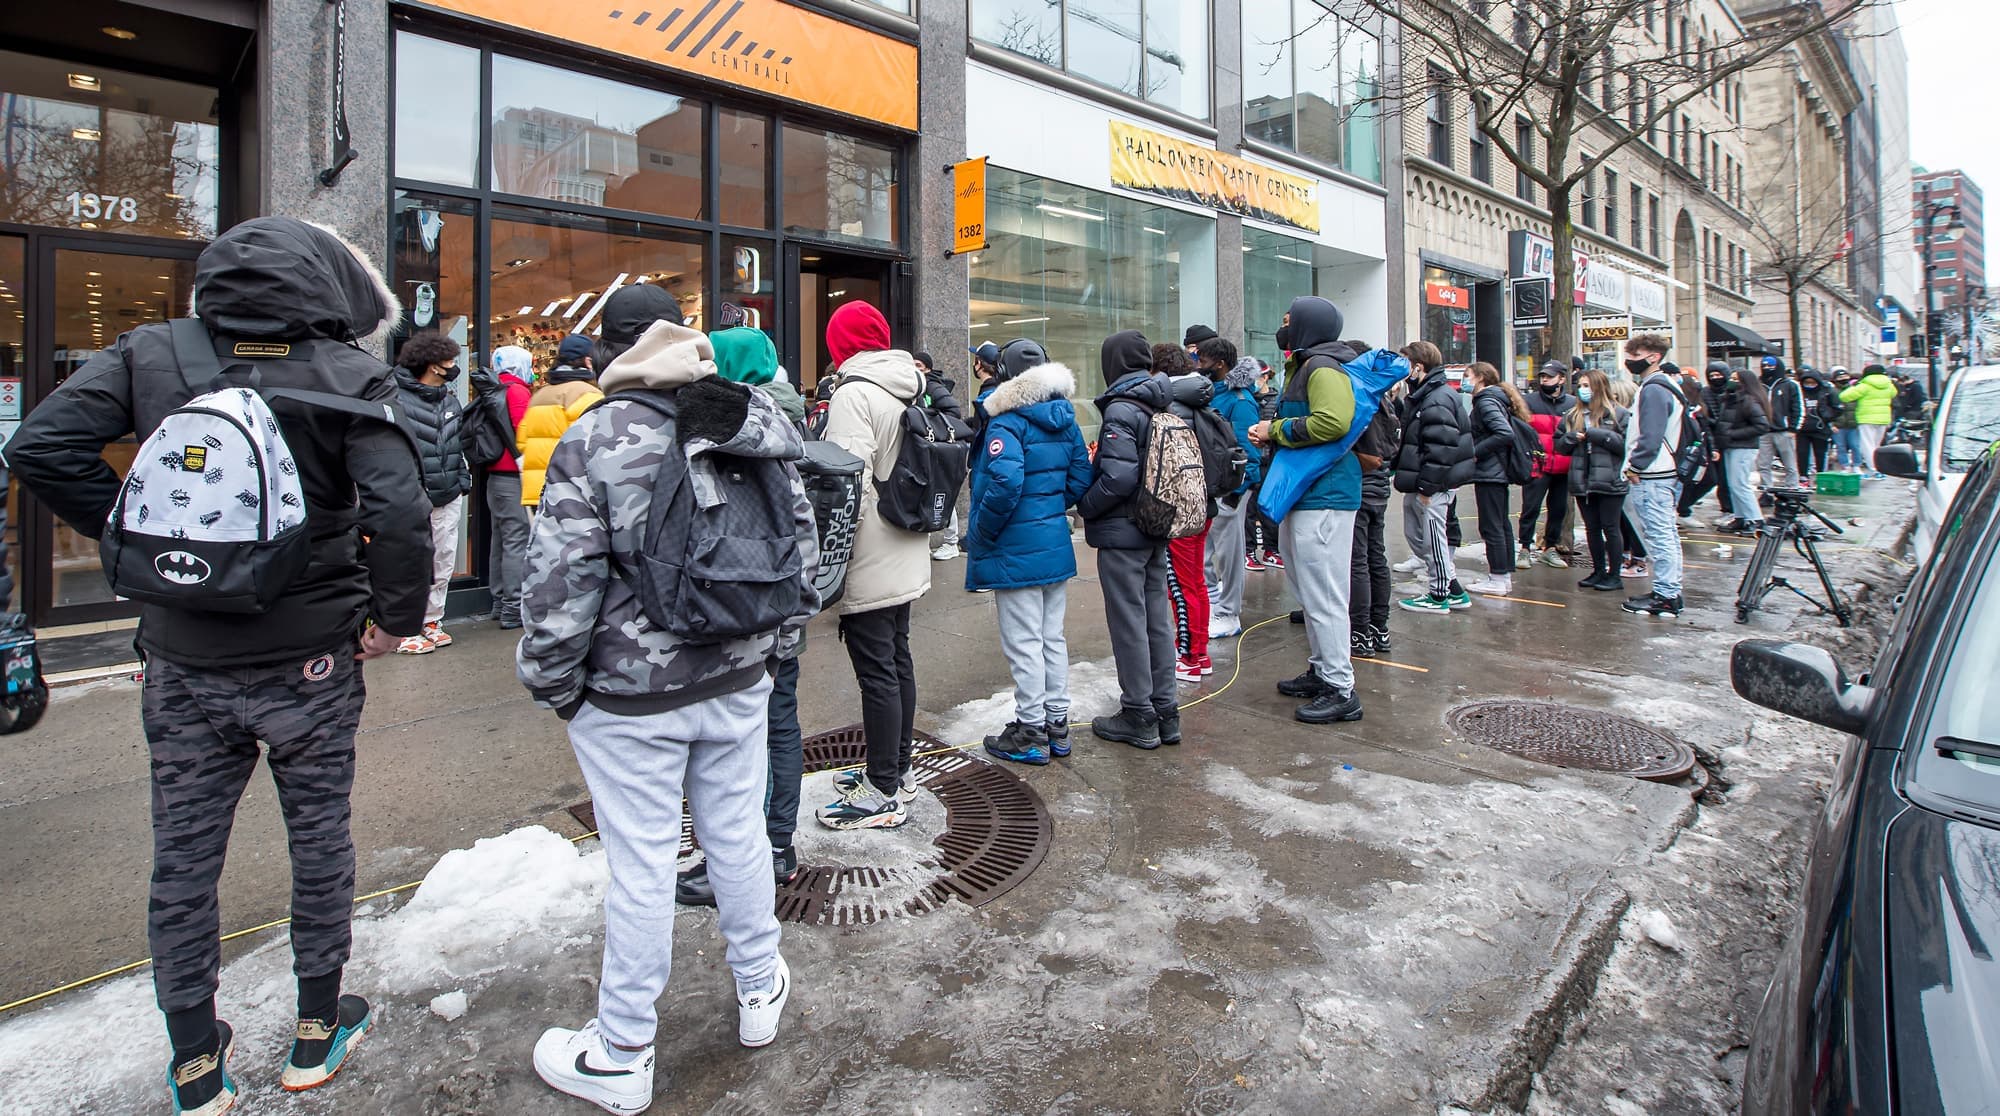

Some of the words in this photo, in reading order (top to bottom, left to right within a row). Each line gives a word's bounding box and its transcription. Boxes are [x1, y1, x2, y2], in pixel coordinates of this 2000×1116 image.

[711, 51, 789, 84] CENTRALL
[1125, 136, 1214, 178] HALLOWEEN
[1222, 163, 1260, 188] PARTY
[1267, 178, 1311, 206] CENTRE
[66, 191, 138, 222] 1378
[959, 223, 981, 239] 1382
[1584, 327, 1627, 338] VASCO
[820, 508, 844, 567] FACE
[832, 484, 855, 564] NORTH
